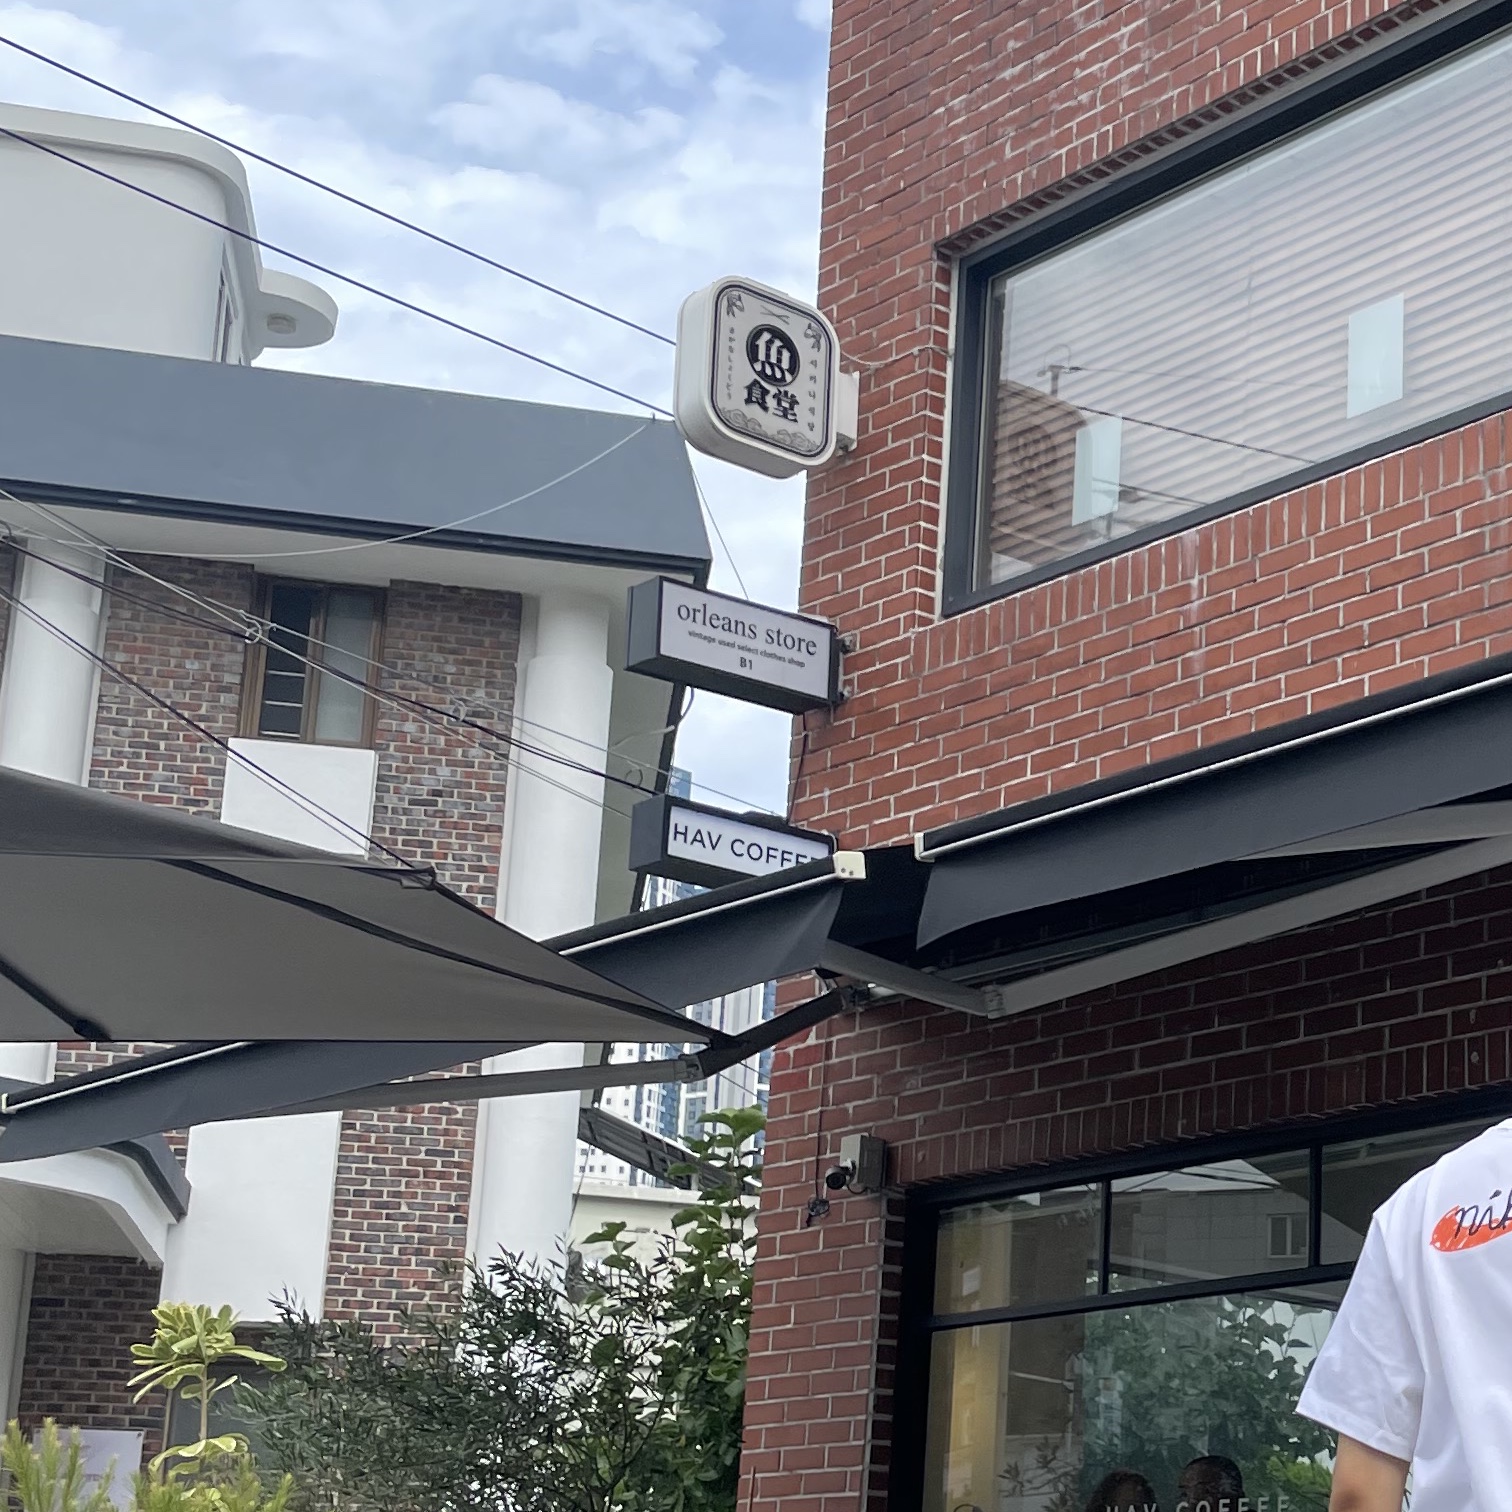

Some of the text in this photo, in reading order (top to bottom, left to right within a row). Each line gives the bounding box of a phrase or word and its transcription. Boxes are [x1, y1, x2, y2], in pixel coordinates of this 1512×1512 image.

[743, 378, 800, 424] 食堂
[677, 603, 817, 656] orleans store
[739, 656, 753, 670] B1
[672, 822, 820, 868] HAV COFFE
